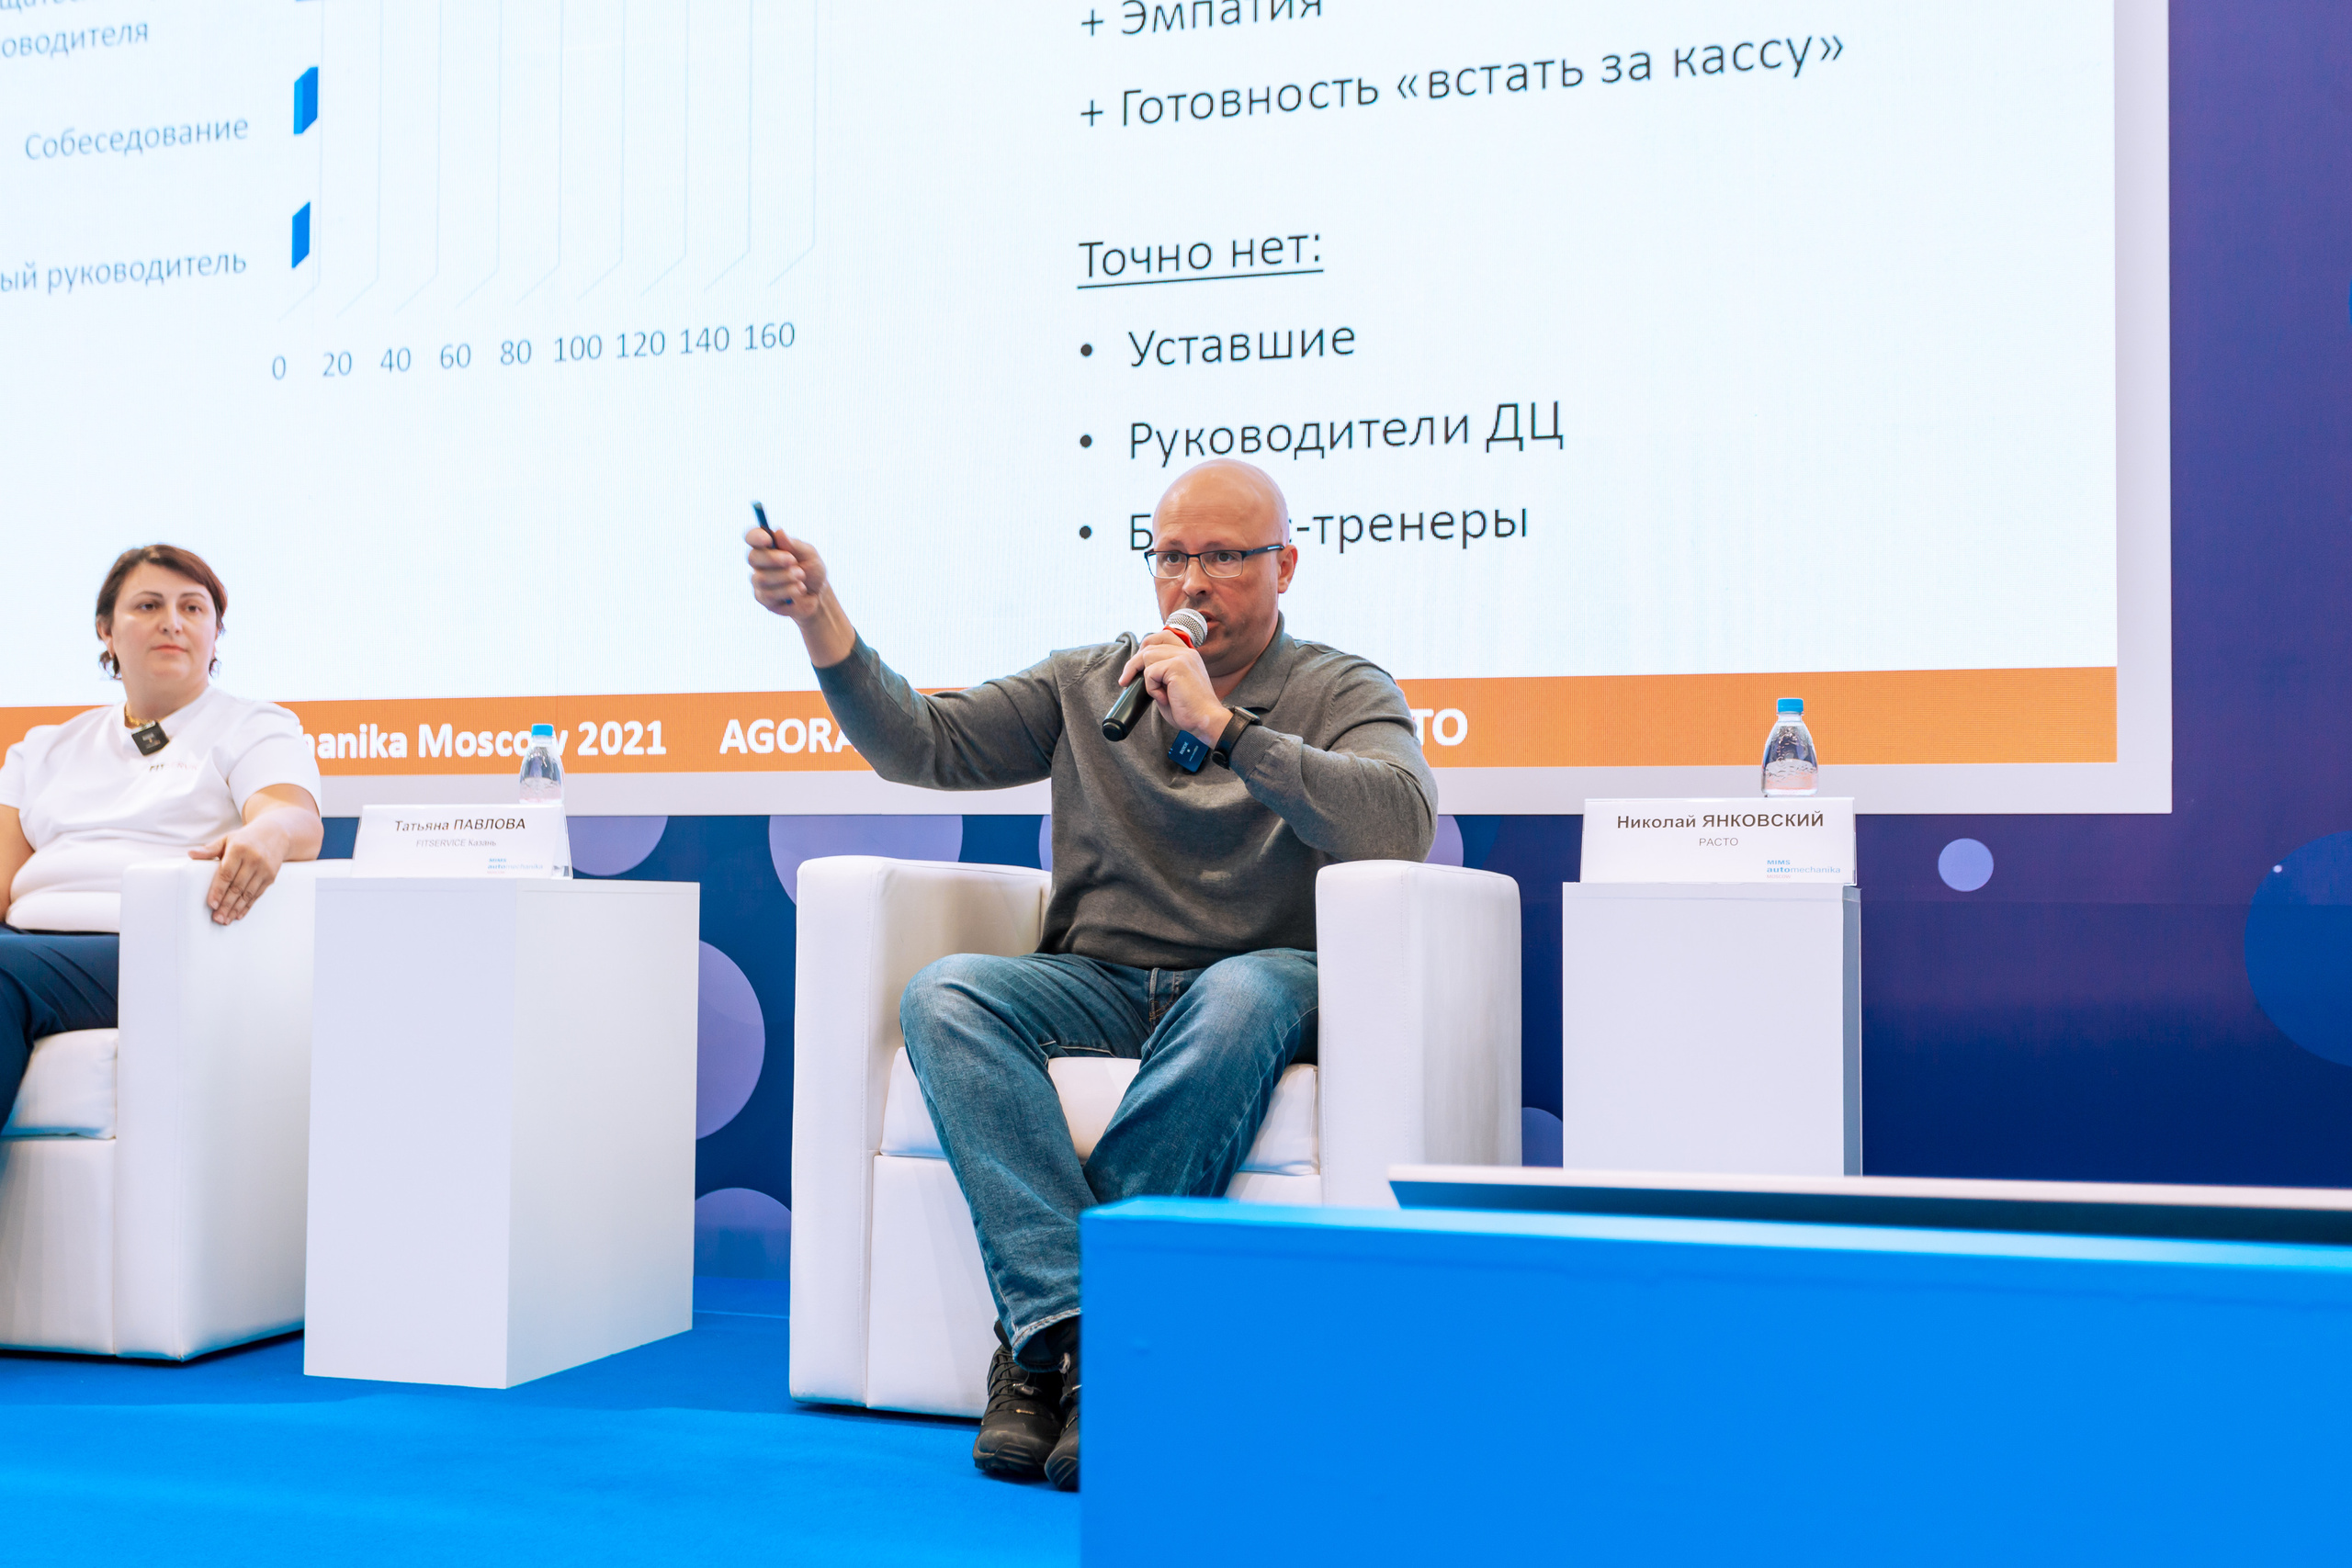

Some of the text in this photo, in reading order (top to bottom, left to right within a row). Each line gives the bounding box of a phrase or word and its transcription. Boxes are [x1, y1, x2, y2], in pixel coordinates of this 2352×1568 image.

[1122, 0, 1321, 35] Эмпатия
[1, 23, 148, 59] оводителя
[1123, 77, 1379, 127] Готовность
[1396, 59, 1584, 99] «встать
[1601, 51, 1652, 84] за
[1674, 35, 1844, 79] кассу»
[25, 118, 249, 161] Собеседование
[48, 253, 247, 295] руководитель
[1078, 231, 1323, 282] Точно нет:
[271, 321, 796, 380] 0 20 40 60 80 100 120 140 160
[1127, 326, 1356, 367] Уставшие
[1130, 400, 1564, 468] Руководители ДЦ
[1130, 508, 1527, 555] Б-тренеры
[576, 719, 667, 756] 2021
[395, 818, 526, 831] Татьяна ПАВЛОВА
[1617, 810, 1824, 829] Николай ЯНКОВСКИЙ
[416, 839, 497, 848] FITSERVICE Казань
